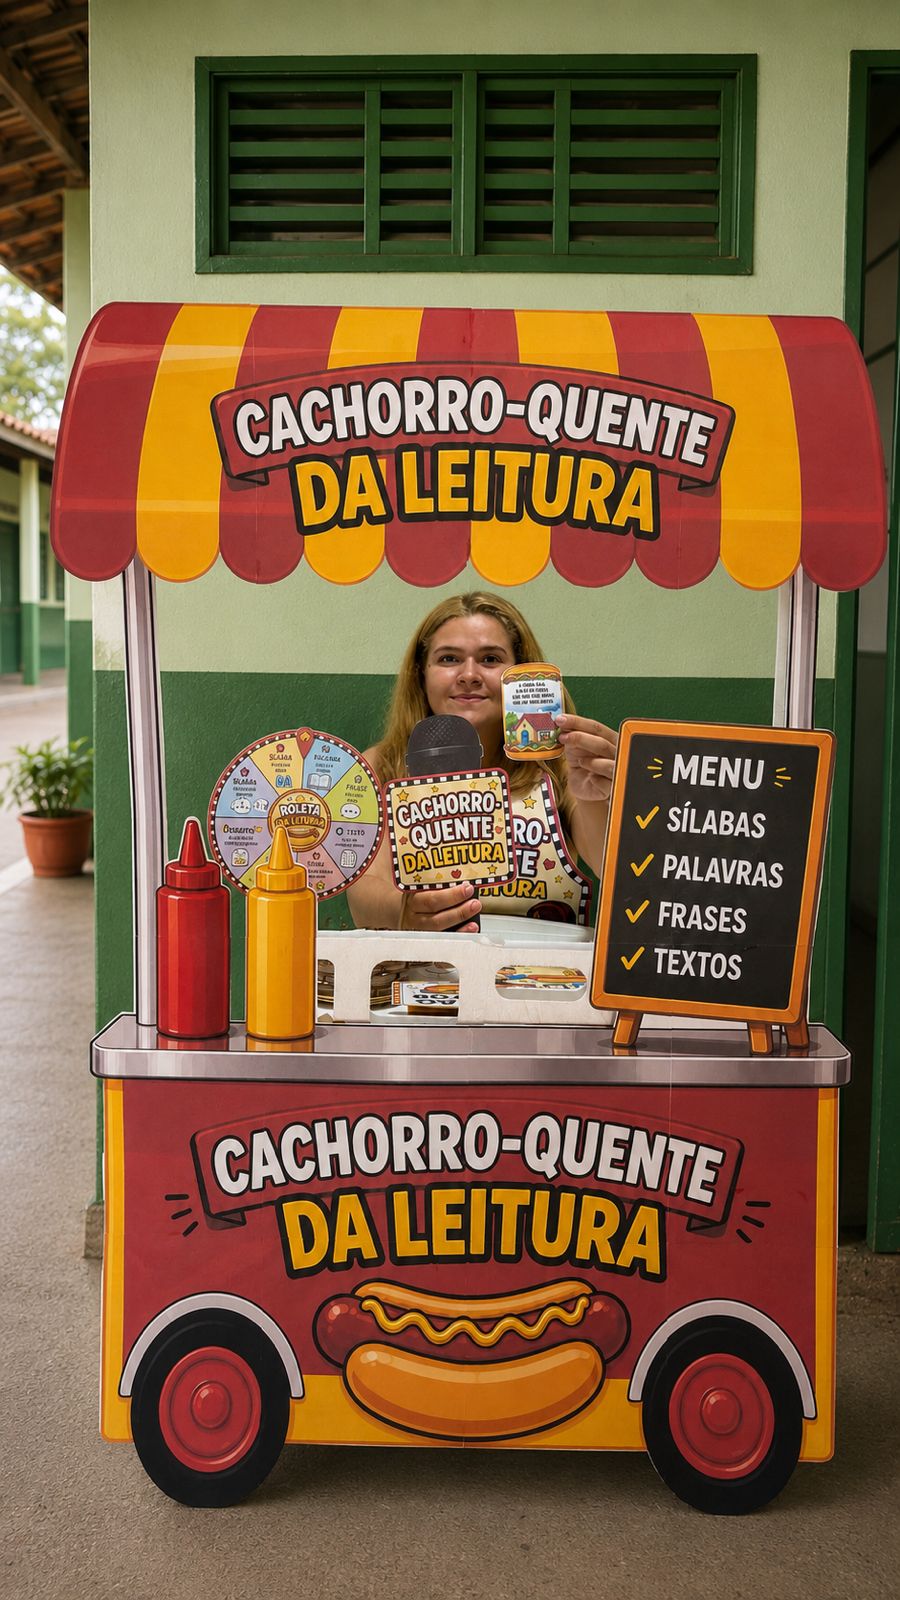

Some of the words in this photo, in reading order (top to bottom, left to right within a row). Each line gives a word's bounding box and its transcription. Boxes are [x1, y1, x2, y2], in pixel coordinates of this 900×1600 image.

[235, 378, 717, 466] CACHORRO-QUENTE
[299, 455, 386, 527] DA
[402, 450, 655, 533] LEITURA
[671, 753, 766, 791] MENU
[280, 803, 321, 817] ROLETA
[396, 791, 502, 829] CACHORRO-
[666, 801, 768, 840] SÍLABAS
[410, 815, 495, 849] QUENTE
[403, 851, 430, 873] DA
[432, 842, 505, 866] LEITURA
[662, 853, 785, 889] PALAVRAS
[657, 901, 747, 935] FRASES
[654, 947, 743, 981] TEXTOS
[213, 1111, 725, 1205] CACHORRO-QUENTE
[282, 1193, 379, 1271] DA
[393, 1187, 661, 1274] LEITURA
